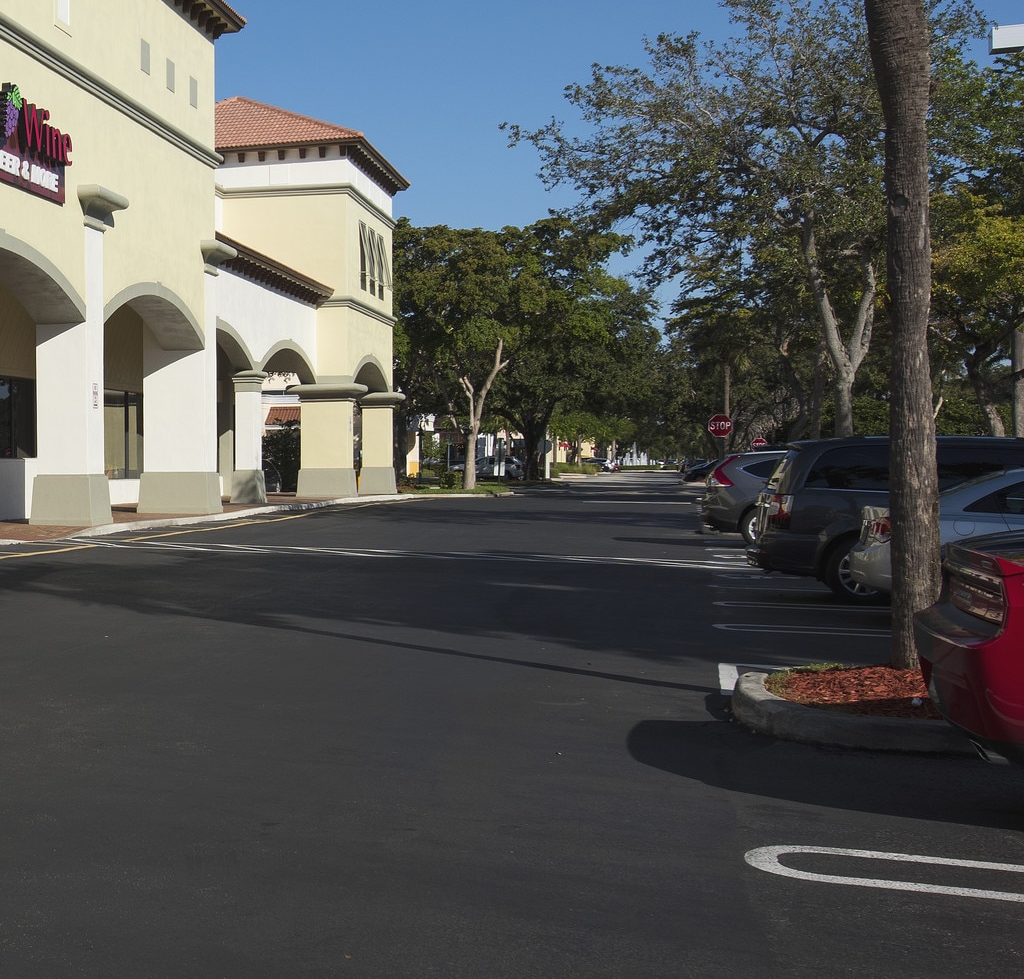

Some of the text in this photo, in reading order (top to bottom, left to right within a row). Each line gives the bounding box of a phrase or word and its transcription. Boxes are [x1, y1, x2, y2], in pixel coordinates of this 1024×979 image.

[20, 96, 72, 166] Wine
[21, 160, 30, 181] &
[31, 163, 59, 193] MORE
[710, 421, 731, 430] STOP
